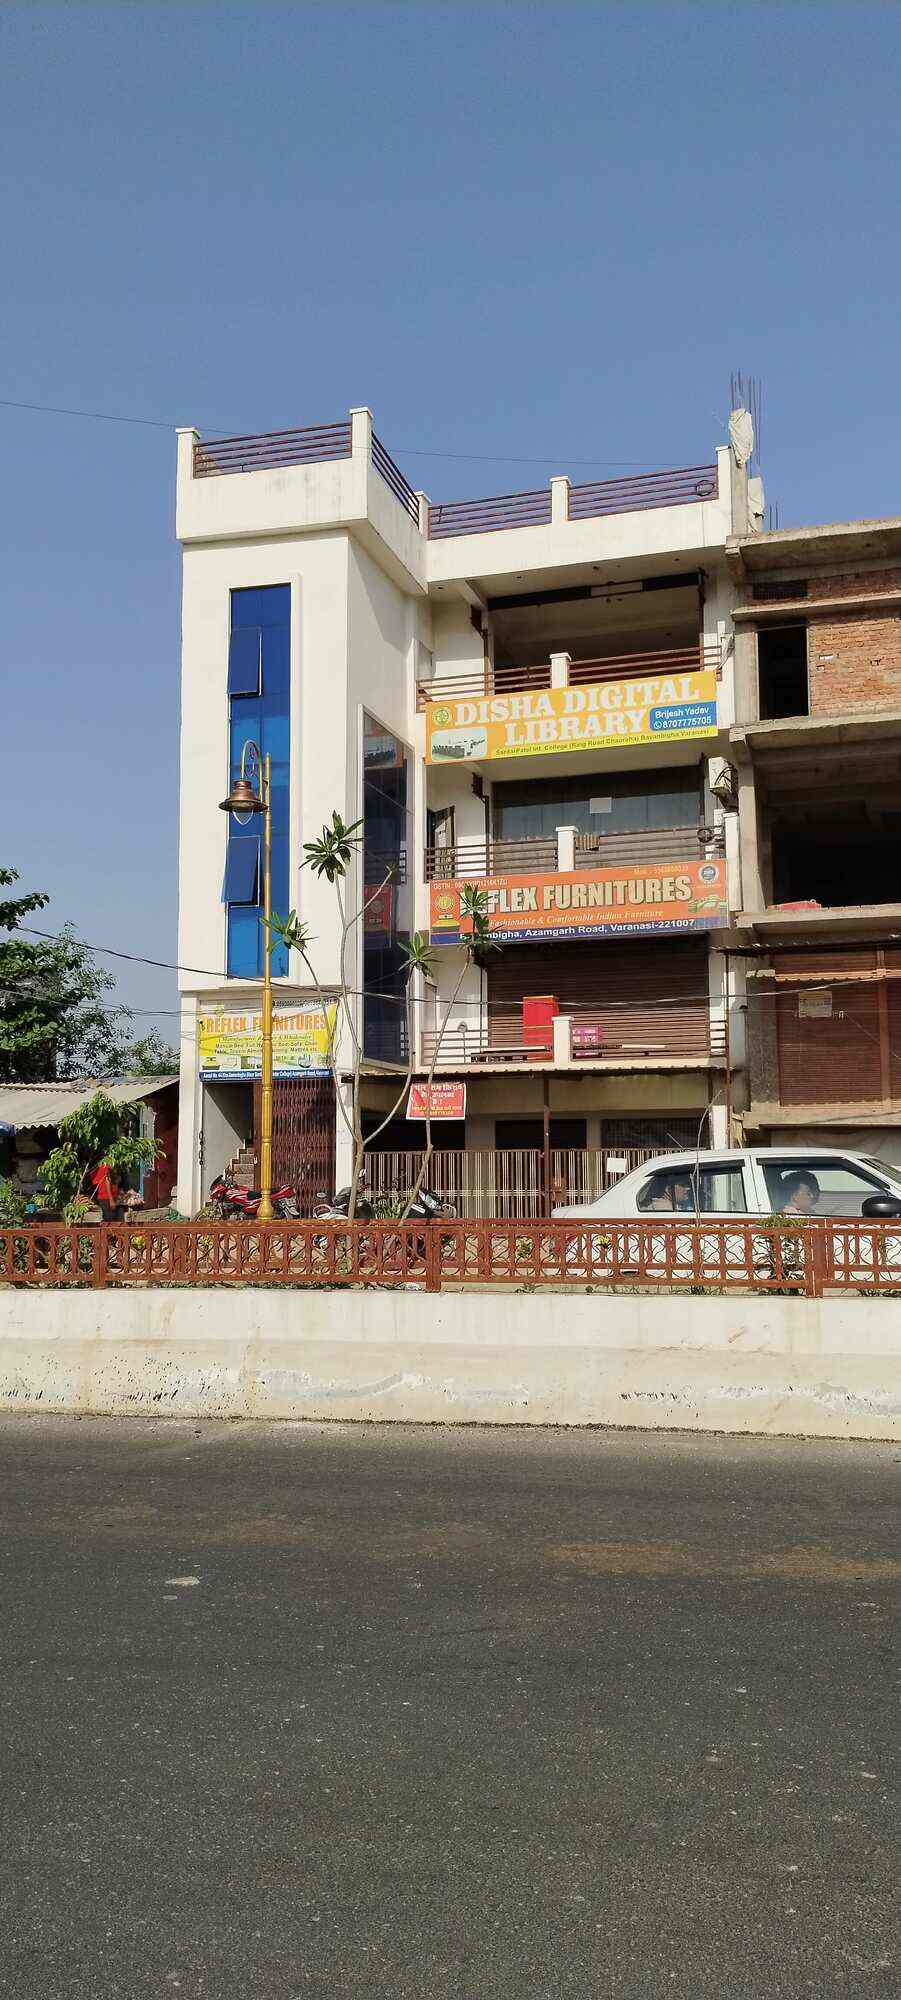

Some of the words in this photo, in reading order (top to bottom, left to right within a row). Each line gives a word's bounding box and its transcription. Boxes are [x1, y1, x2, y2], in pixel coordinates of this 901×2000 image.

[455, 693, 556, 726] DISHA
[563, 677, 700, 713] DIGITAL
[655, 708, 683, 720] Brijesh
[684, 706, 709, 716] Yadav
[505, 708, 648, 747] LIBRARY
[662, 715, 712, 729] 8707775705
[543, 875, 693, 911] FURNITURES
[525, 925, 575, 938] Azamgarh
[578, 924, 608, 935] Road,
[610, 918, 695, 932] Varanasi-221007
